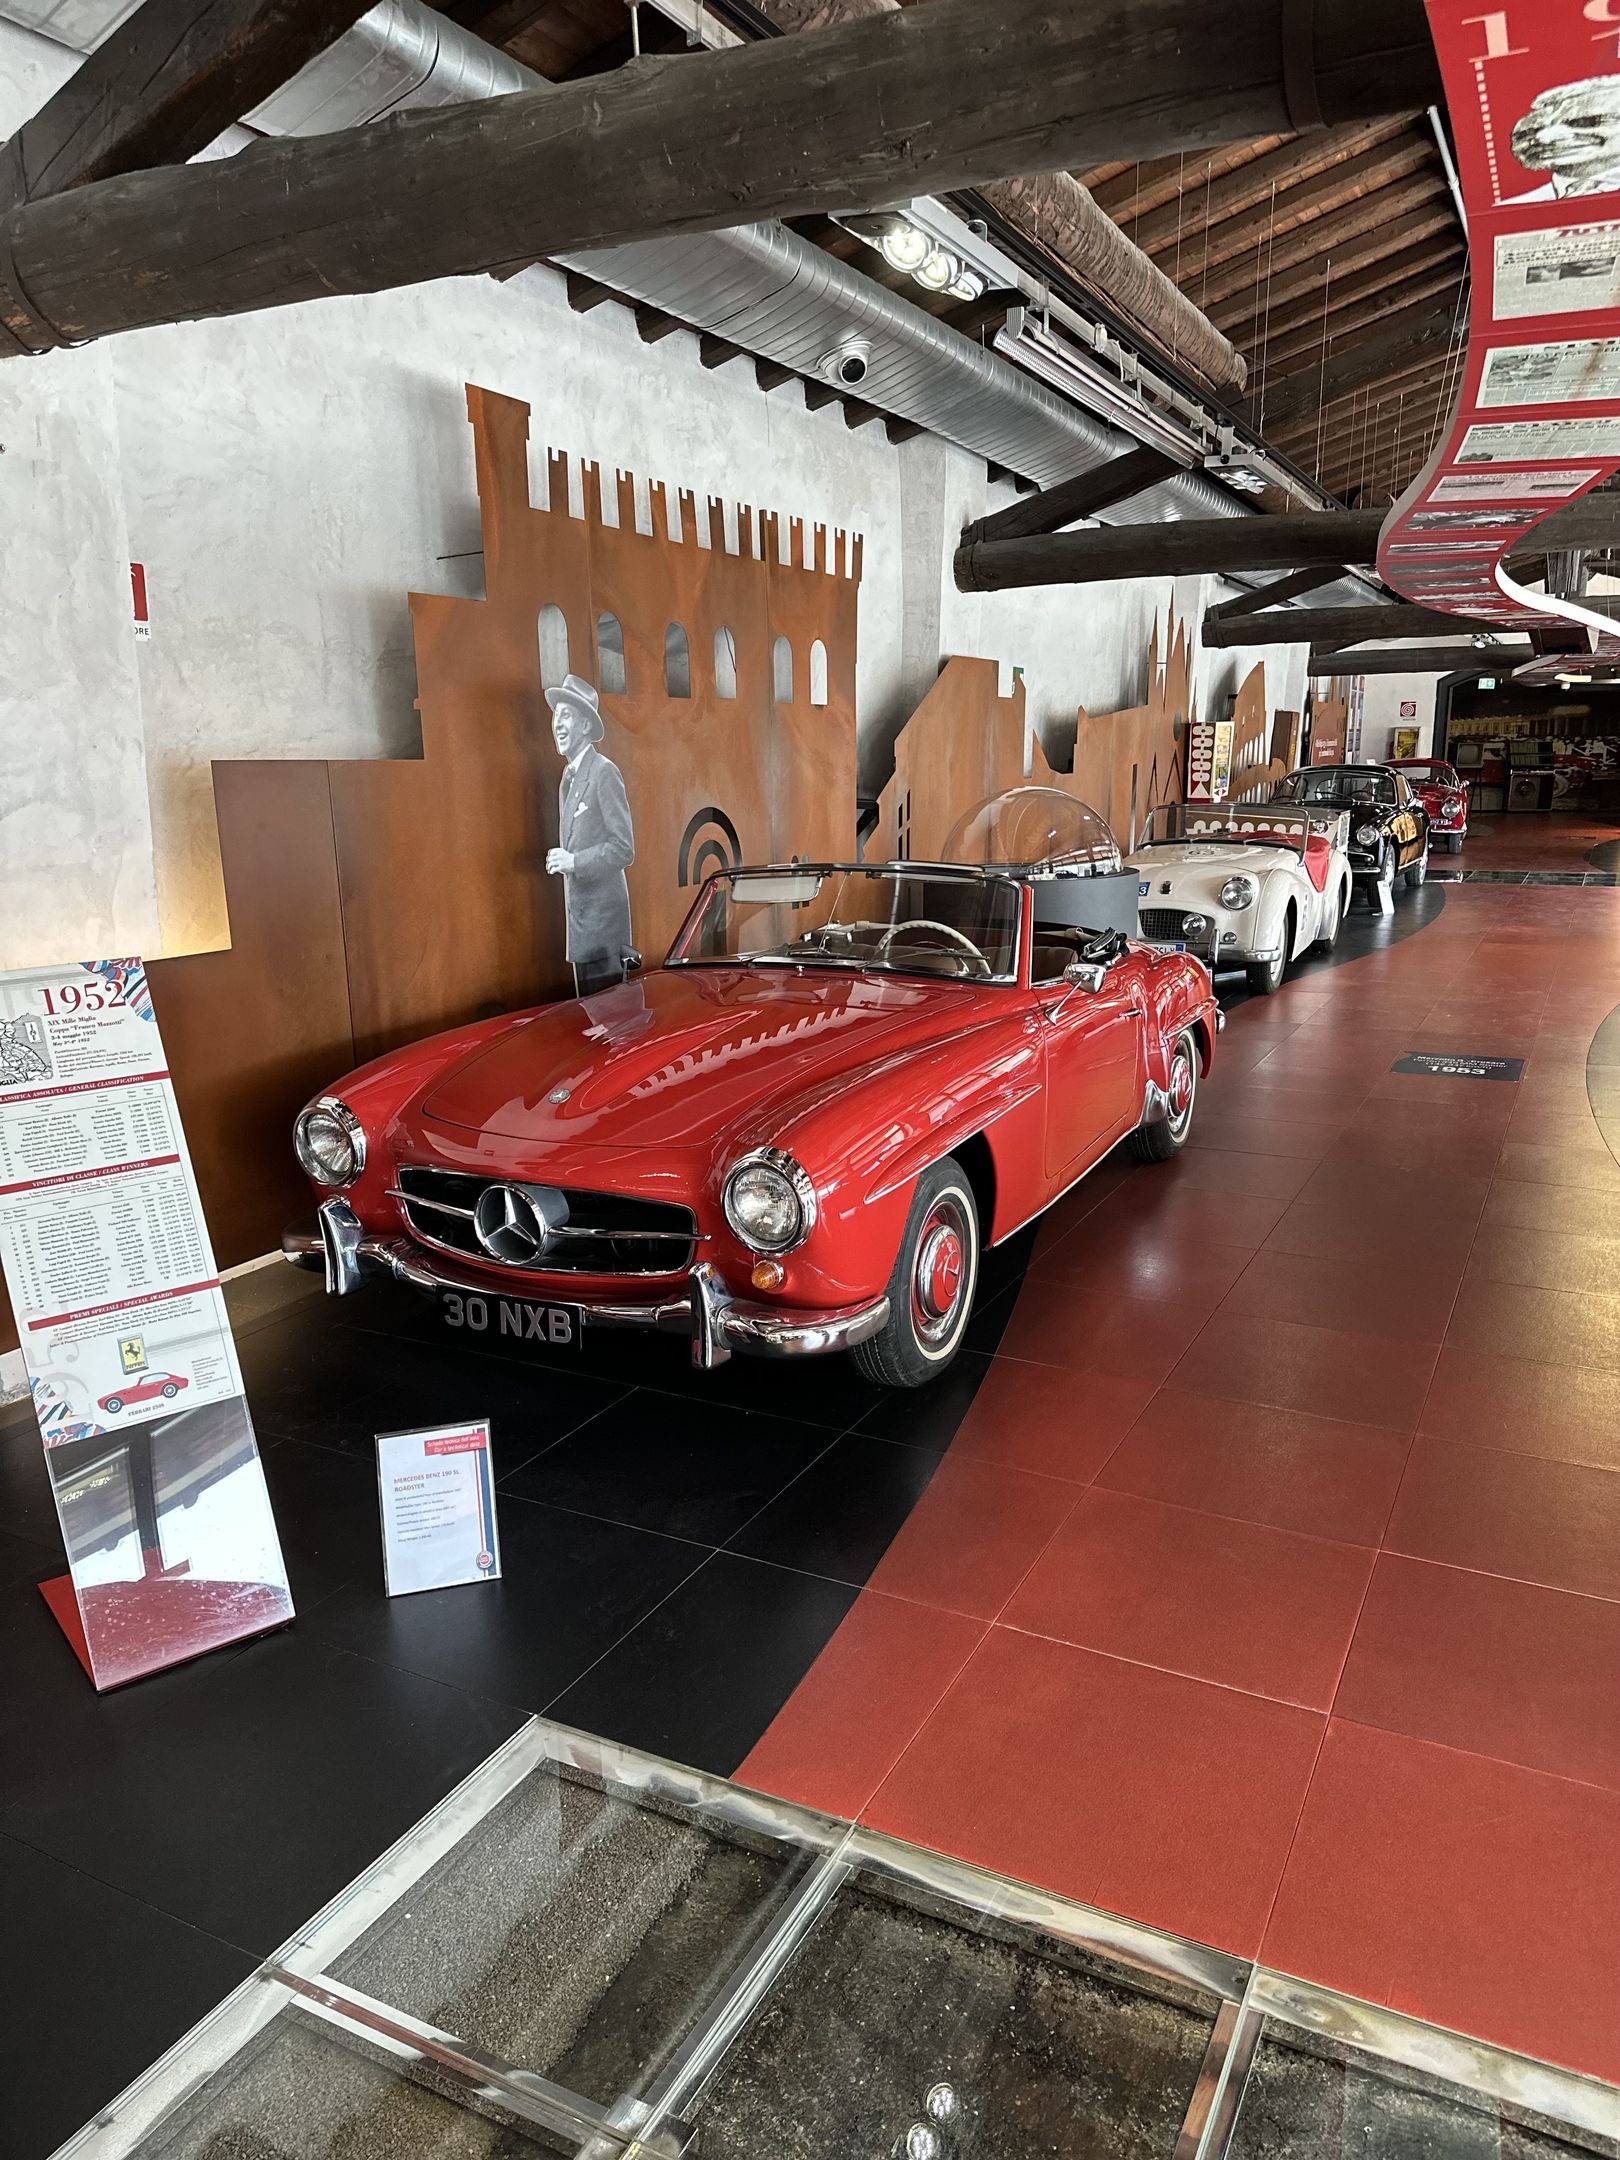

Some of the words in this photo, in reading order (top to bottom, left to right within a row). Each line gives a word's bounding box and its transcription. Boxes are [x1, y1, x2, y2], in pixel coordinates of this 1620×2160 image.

[38, 980, 126, 1016] 1952
[79, 1015, 97, 1024] Miglia
[1427, 1065, 1486, 1075] 1953
[32, 1087, 64, 1098] ASSOLUTA
[68, 1083, 97, 1092] GENERAL
[97, 1075, 144, 1088] CLASSIFICATION
[31, 1176, 65, 1188] VINCITORI
[66, 1174, 75, 1182] DI
[75, 1171, 98, 1180] CLASSE
[101, 1166, 121, 1175] CLASS
[121, 1161, 149, 1172] WINNERS
[69, 1310, 90, 1320] PREMI
[90, 1303, 120, 1315] SPECIALI
[123, 1296, 149, 1307] SPECIAL
[149, 1291, 174, 1301] AWARDS
[442, 1293, 489, 1331] 30
[499, 1300, 572, 1344] NXB
[127, 1405, 152, 1417] FERRARI
[393, 1474, 425, 1484] MERCEDES
[425, 1472, 441, 1480] BENZ
[442, 1469, 453, 1477] 190
[394, 1483, 425, 1492] ROADSTER
